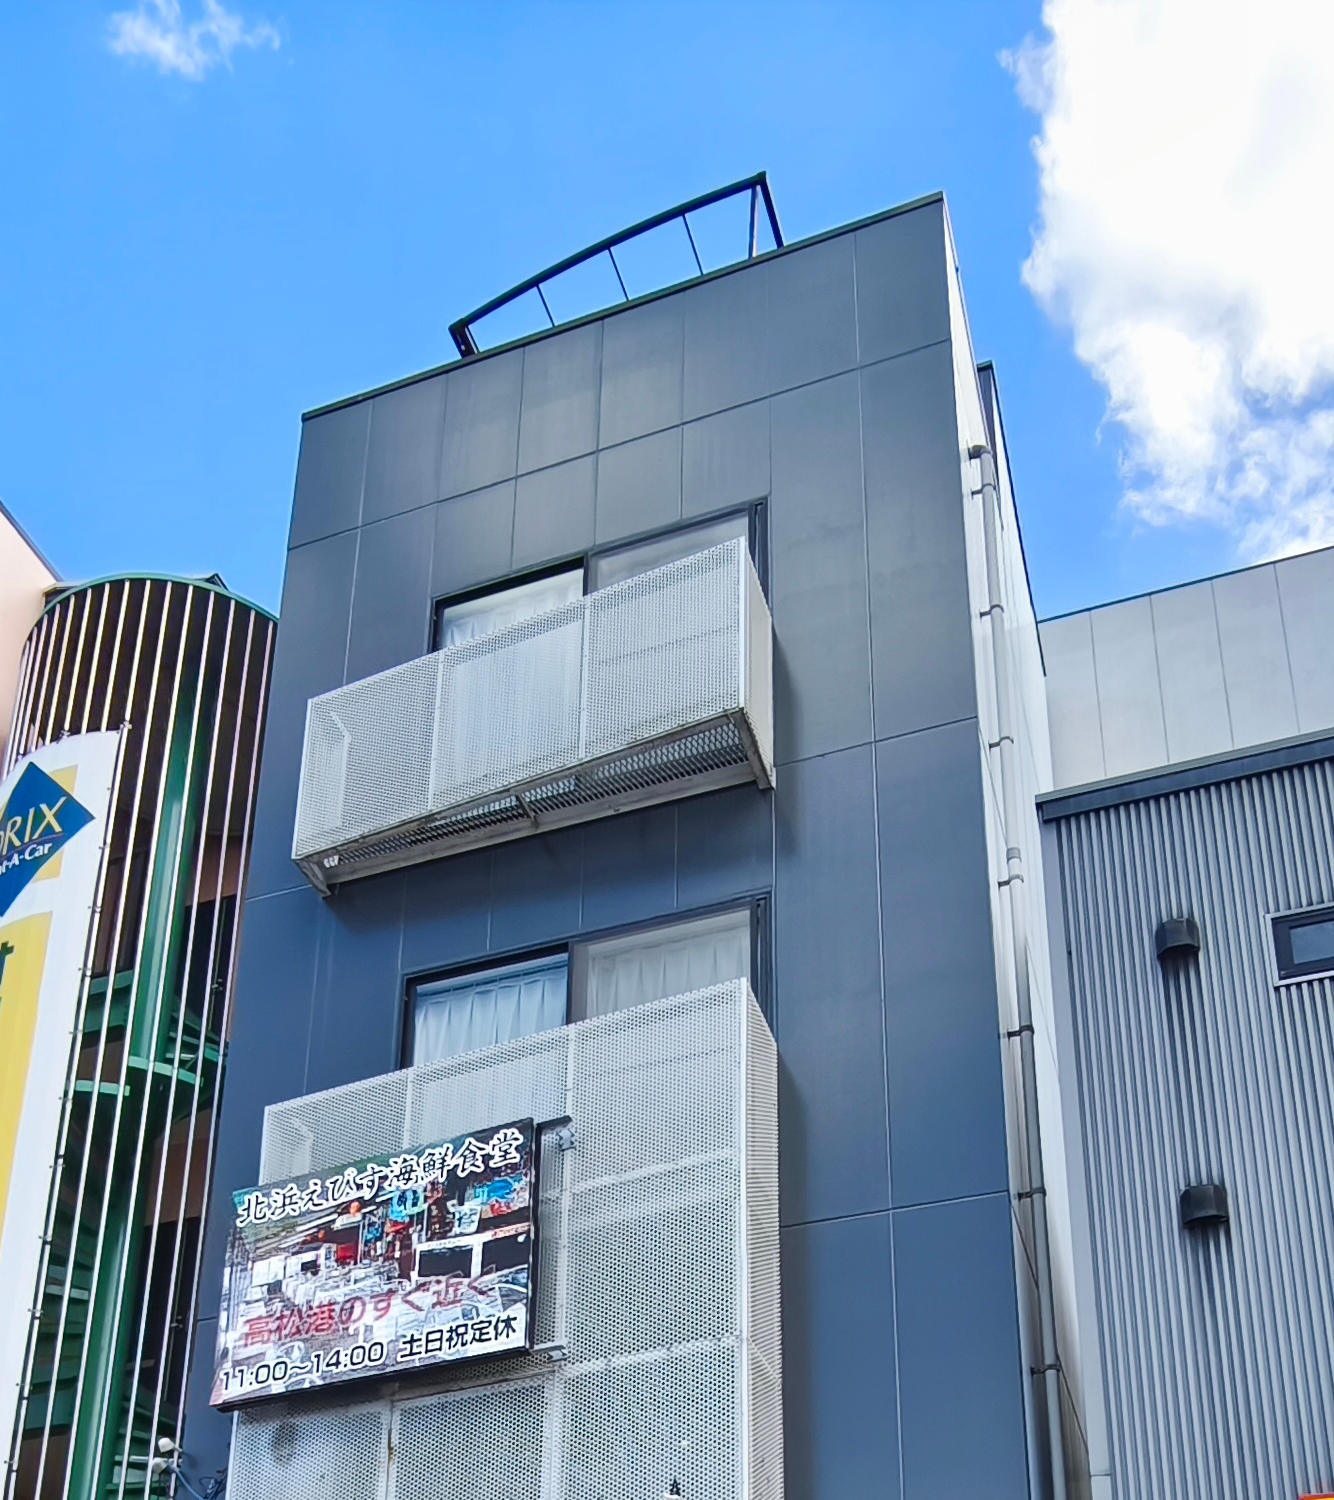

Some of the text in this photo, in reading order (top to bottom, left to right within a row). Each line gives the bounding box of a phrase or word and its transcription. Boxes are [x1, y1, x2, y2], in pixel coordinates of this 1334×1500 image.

[237, 1128, 524, 1227] 北浜えびす海鮮食堂
[243, 1276, 496, 1347] 高松港のすぐ近く
[400, 1315, 518, 1360] 土日祝定休
